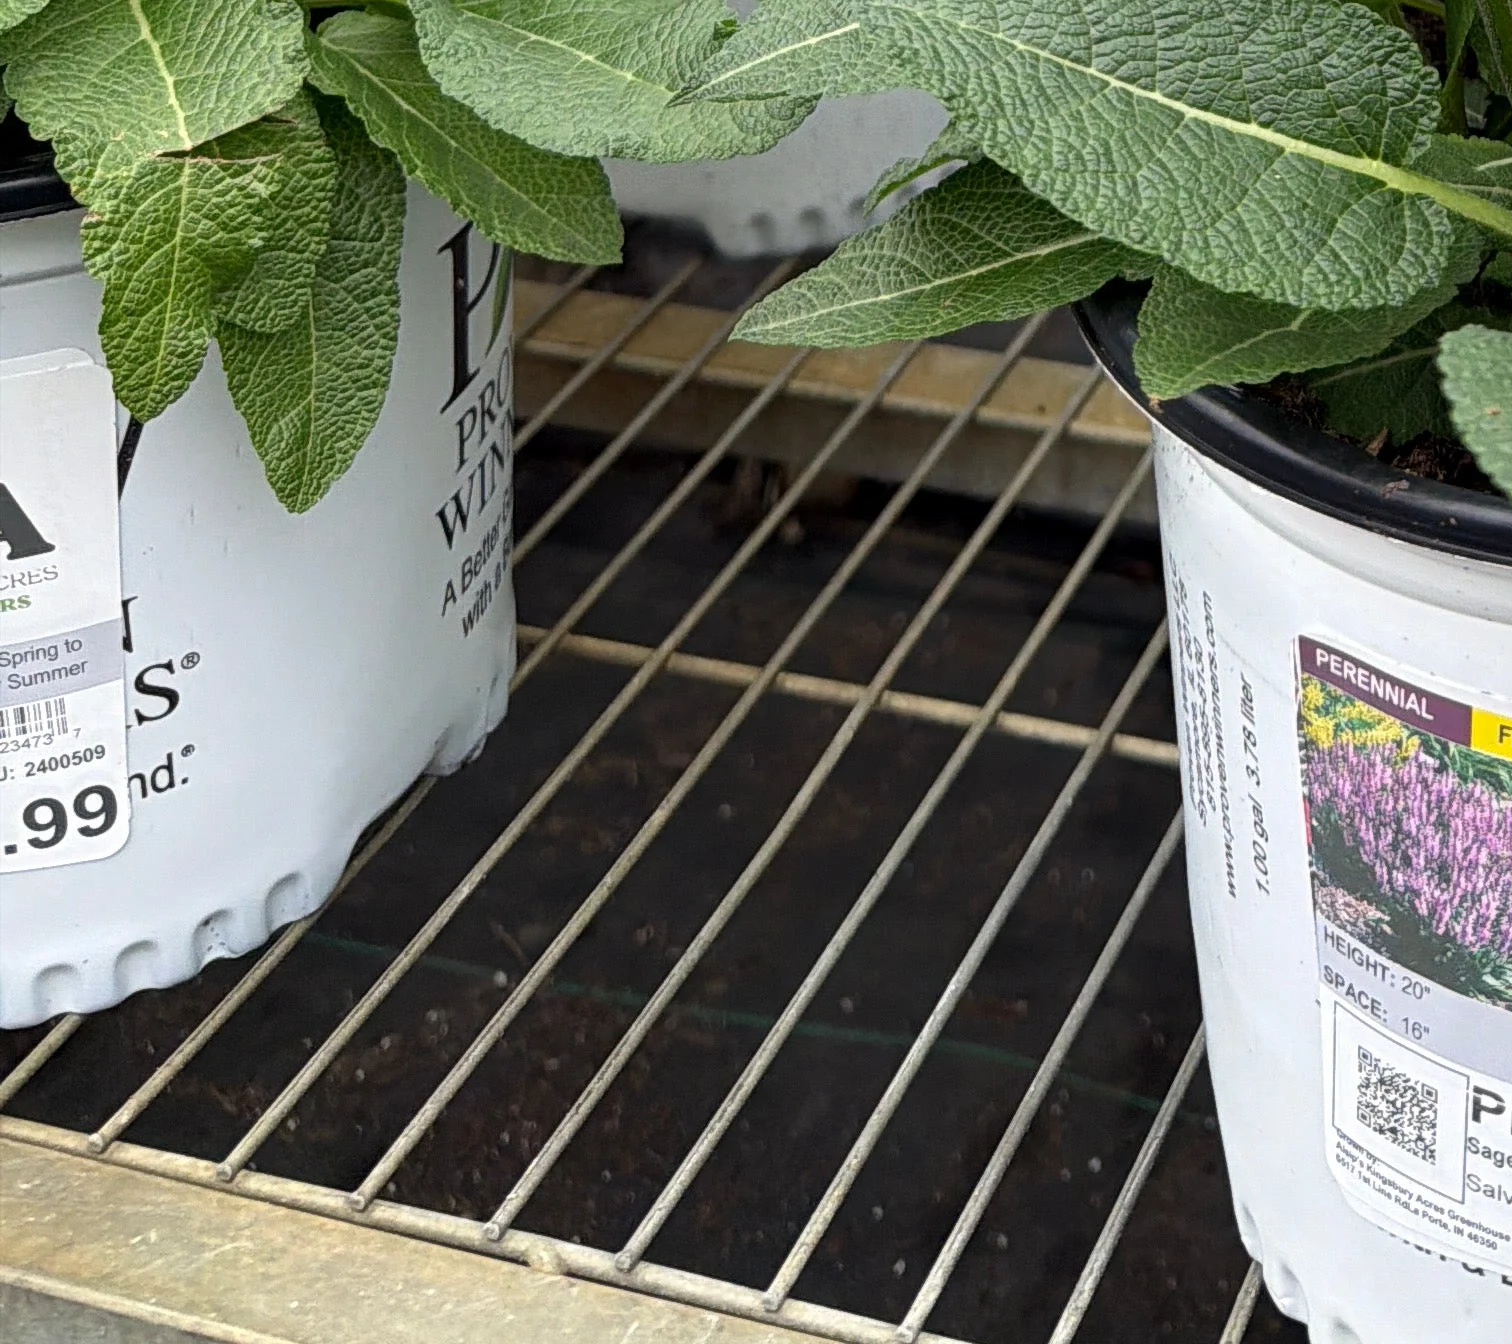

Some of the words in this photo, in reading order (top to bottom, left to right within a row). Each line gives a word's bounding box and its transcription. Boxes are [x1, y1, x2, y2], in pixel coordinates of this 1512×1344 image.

[0, 565, 59, 591] CRES
[441, 579, 457, 617] A
[64, 638, 83, 653] to
[8, 660, 88, 690] Summer
[1240, 672, 1256, 727] liter
[1315, 647, 1435, 722] PERENNIAL
[24, 744, 106, 778] 2400509
[1202, 590, 1238, 900] www.provenwinners.com
[1243, 724, 1261, 788] 3.78
[4, 784, 118, 855] .99
[1247, 793, 1269, 844] gal
[1253, 839, 1271, 897] 1.00
[1323, 924, 1396, 989] HEIGHT:
[1401, 975, 1432, 1001] 20"
[1322, 964, 1388, 1024] SPACE:
[1401, 1015, 1430, 1041] 16"
[1366, 1163, 1414, 1201] Kingsbury
[1415, 1194, 1446, 1217] Acres
[1447, 1208, 1512, 1243] Greenhouse
[1453, 1225, 1465, 1238] IN
[1466, 1230, 1499, 1252] 46350
